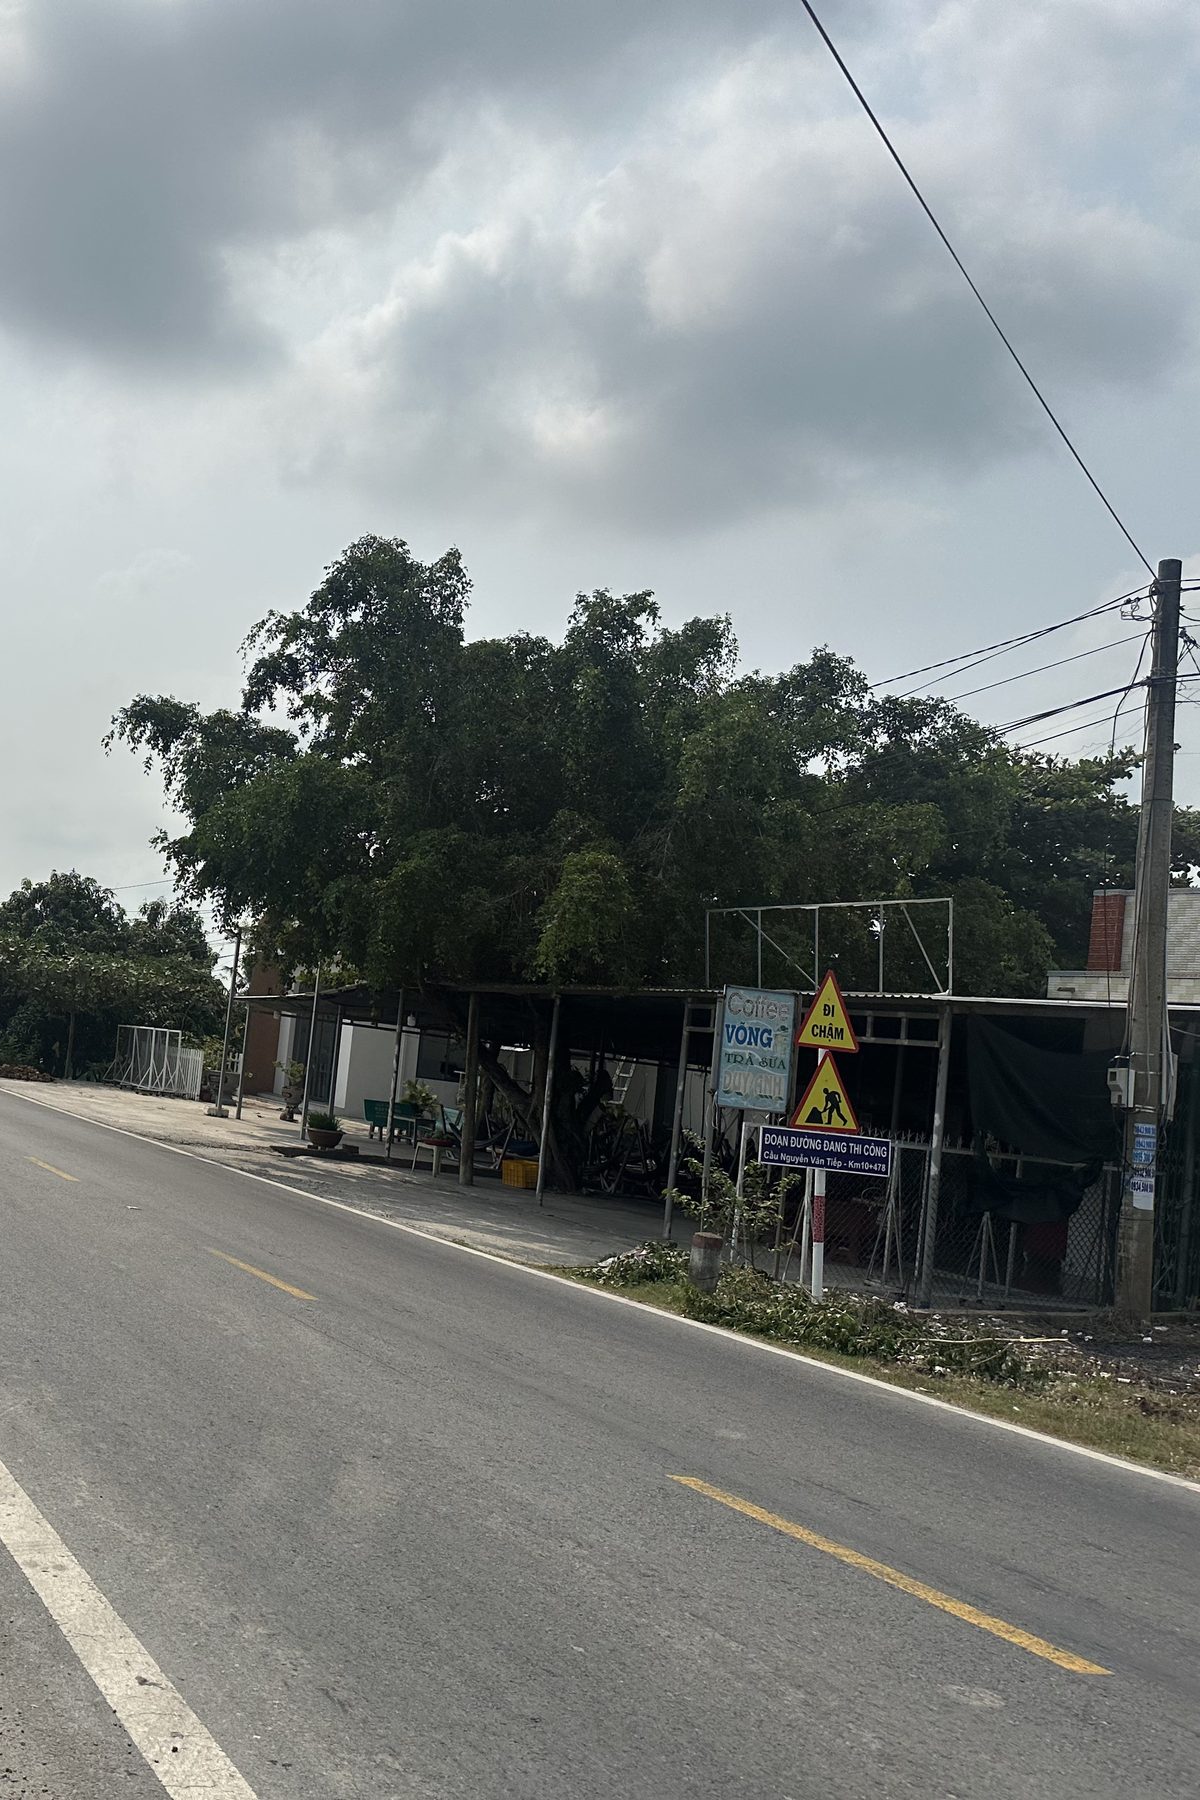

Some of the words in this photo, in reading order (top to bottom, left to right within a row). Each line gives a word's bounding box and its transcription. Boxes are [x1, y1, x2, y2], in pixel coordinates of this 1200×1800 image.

[727, 992, 789, 1021] Coffee
[823, 1003, 835, 1018] ĐI
[725, 1021, 773, 1049] VÕNG
[811, 1022, 844, 1042] CHẬM
[725, 1051, 755, 1066] TRÀ
[764, 1133, 789, 1149] ĐOẠN
[790, 1135, 822, 1150] ĐƯỜNG
[823, 1140, 847, 1153] ĐANG
[849, 1142, 862, 1155] THI
[863, 1142, 887, 1158] CÔNG
[763, 1150, 779, 1160] Cầu
[780, 1152, 809, 1164] Nguyễn
[810, 1155, 825, 1166] Văn
[826, 1157, 842, 1169] Tiếp
[848, 1160, 886, 1172] Km10+478
